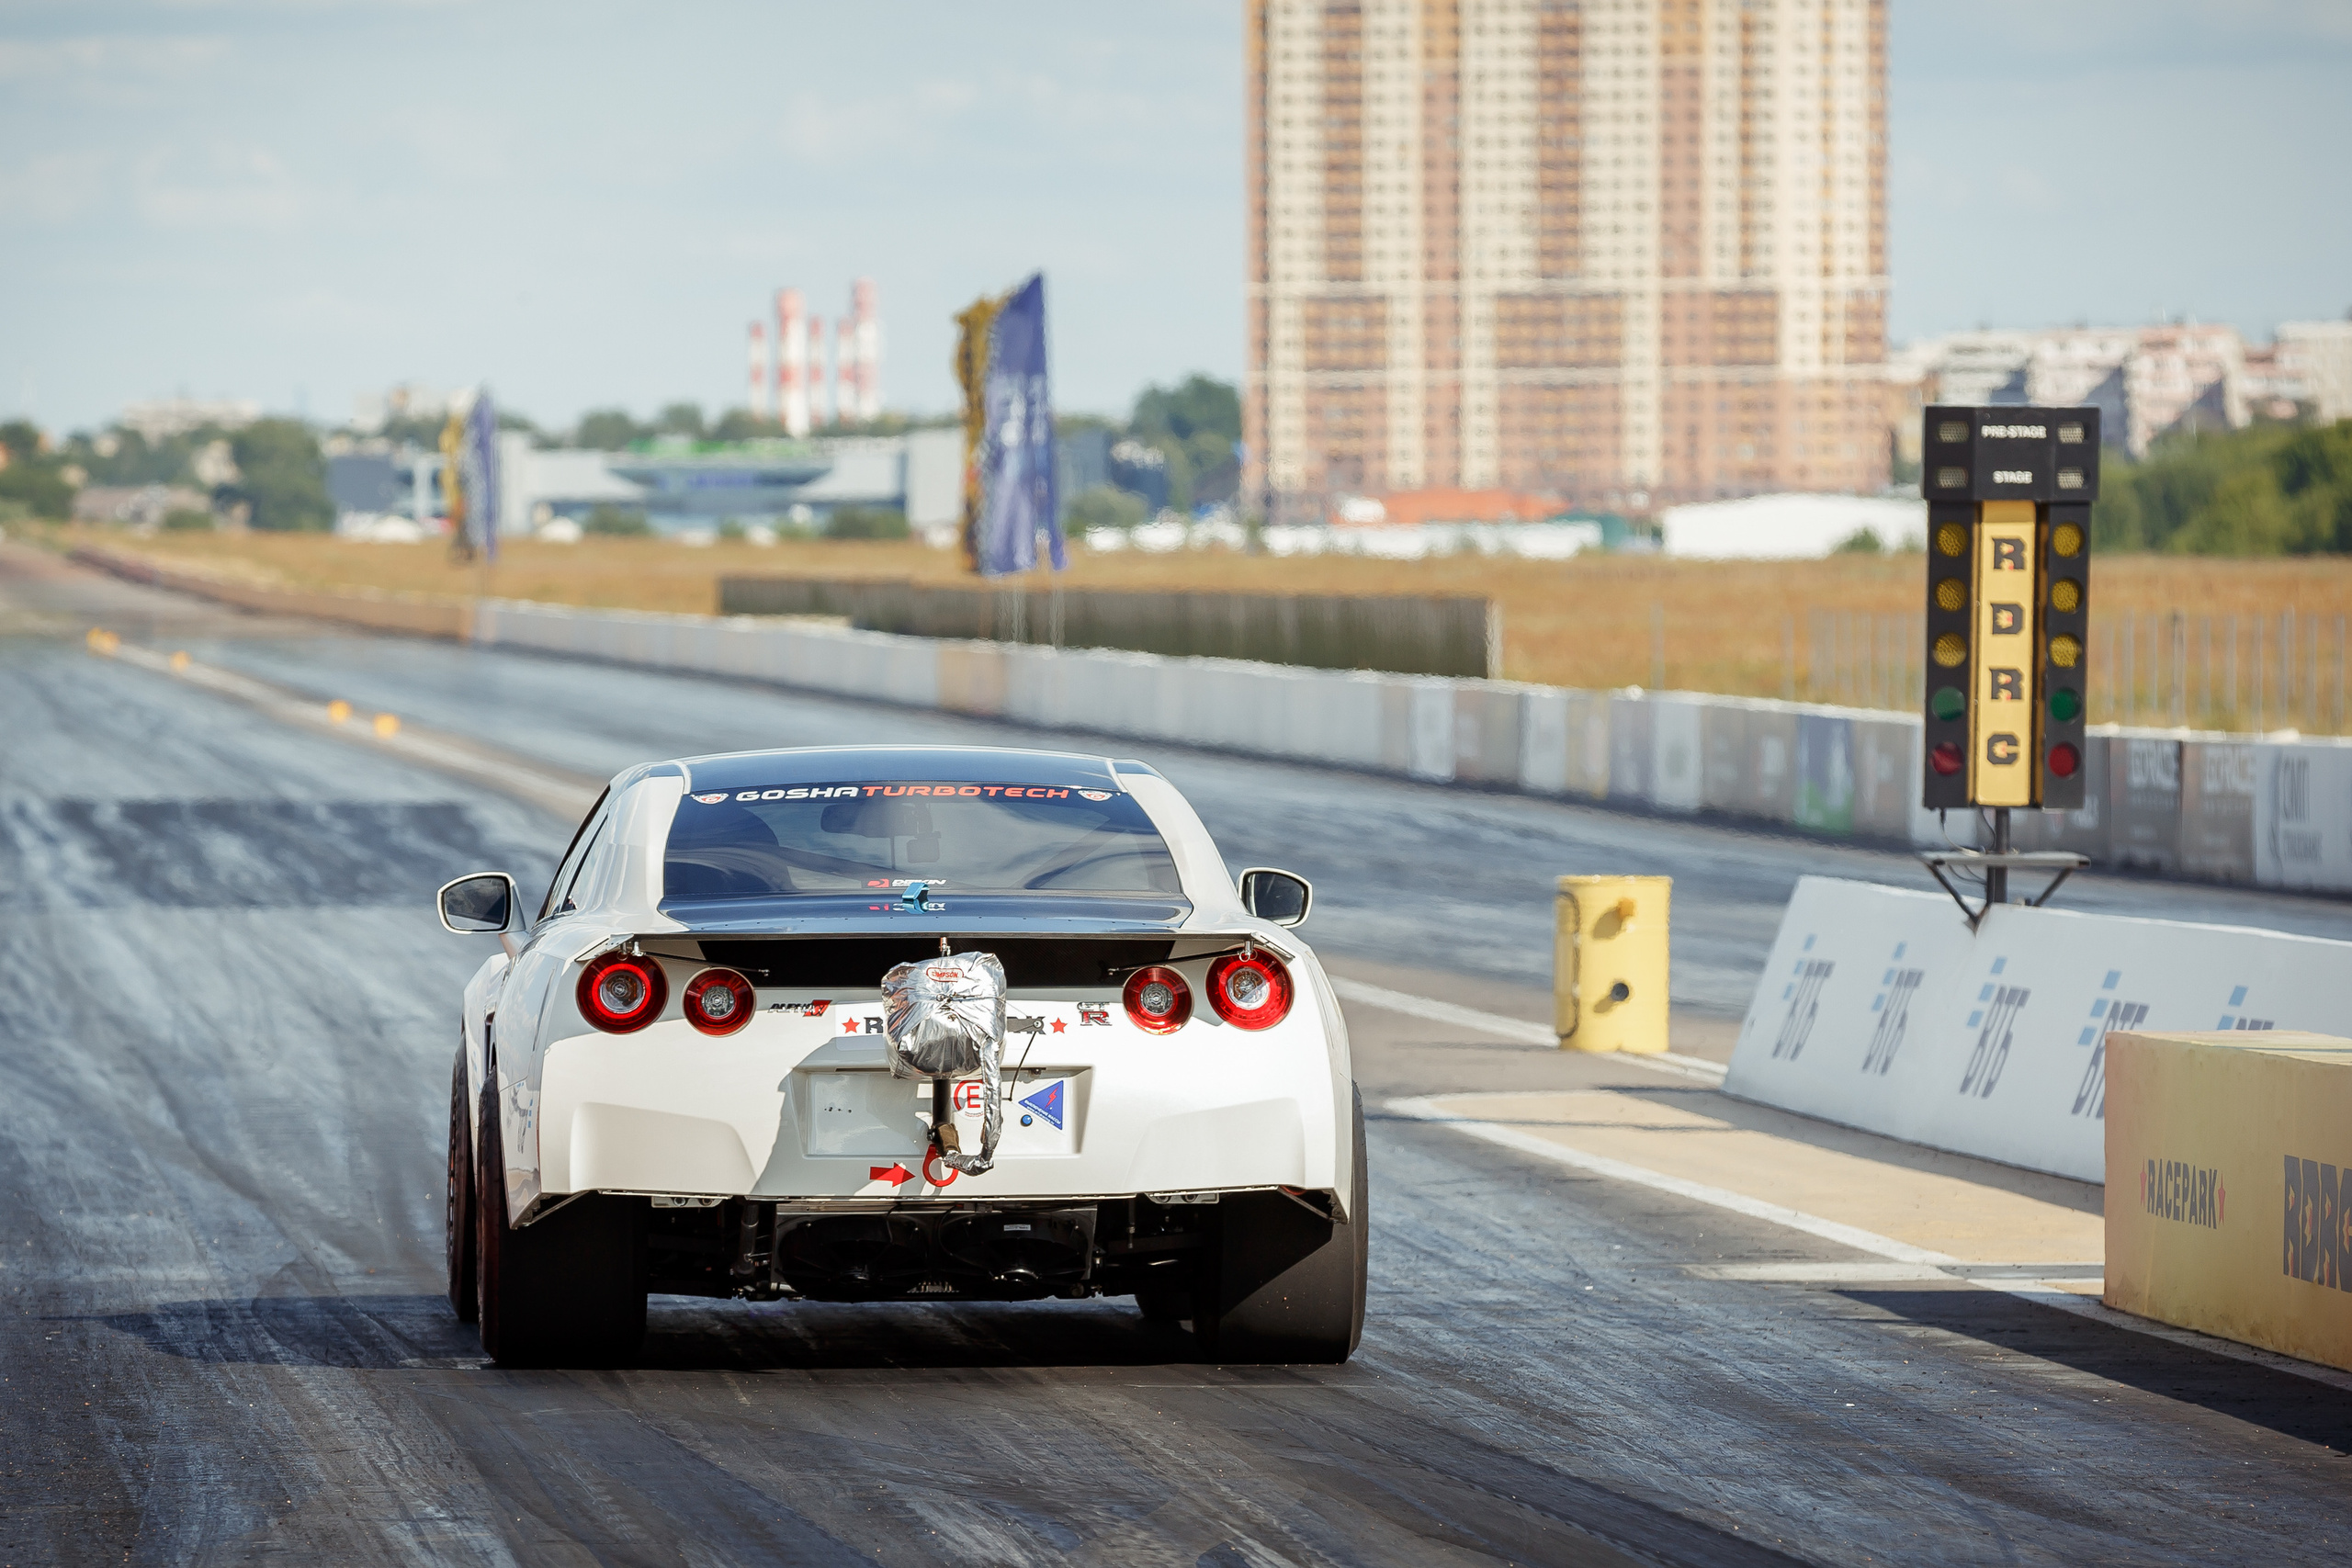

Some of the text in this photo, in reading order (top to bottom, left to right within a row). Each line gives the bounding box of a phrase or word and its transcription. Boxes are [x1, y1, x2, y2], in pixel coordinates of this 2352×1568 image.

[1992, 470, 2033, 484] STAGE
[1080, 1010, 1113, 1026] R
[967, 1085, 981, 1109] E
[2147, 1157, 2218, 1230] RACEPARK
